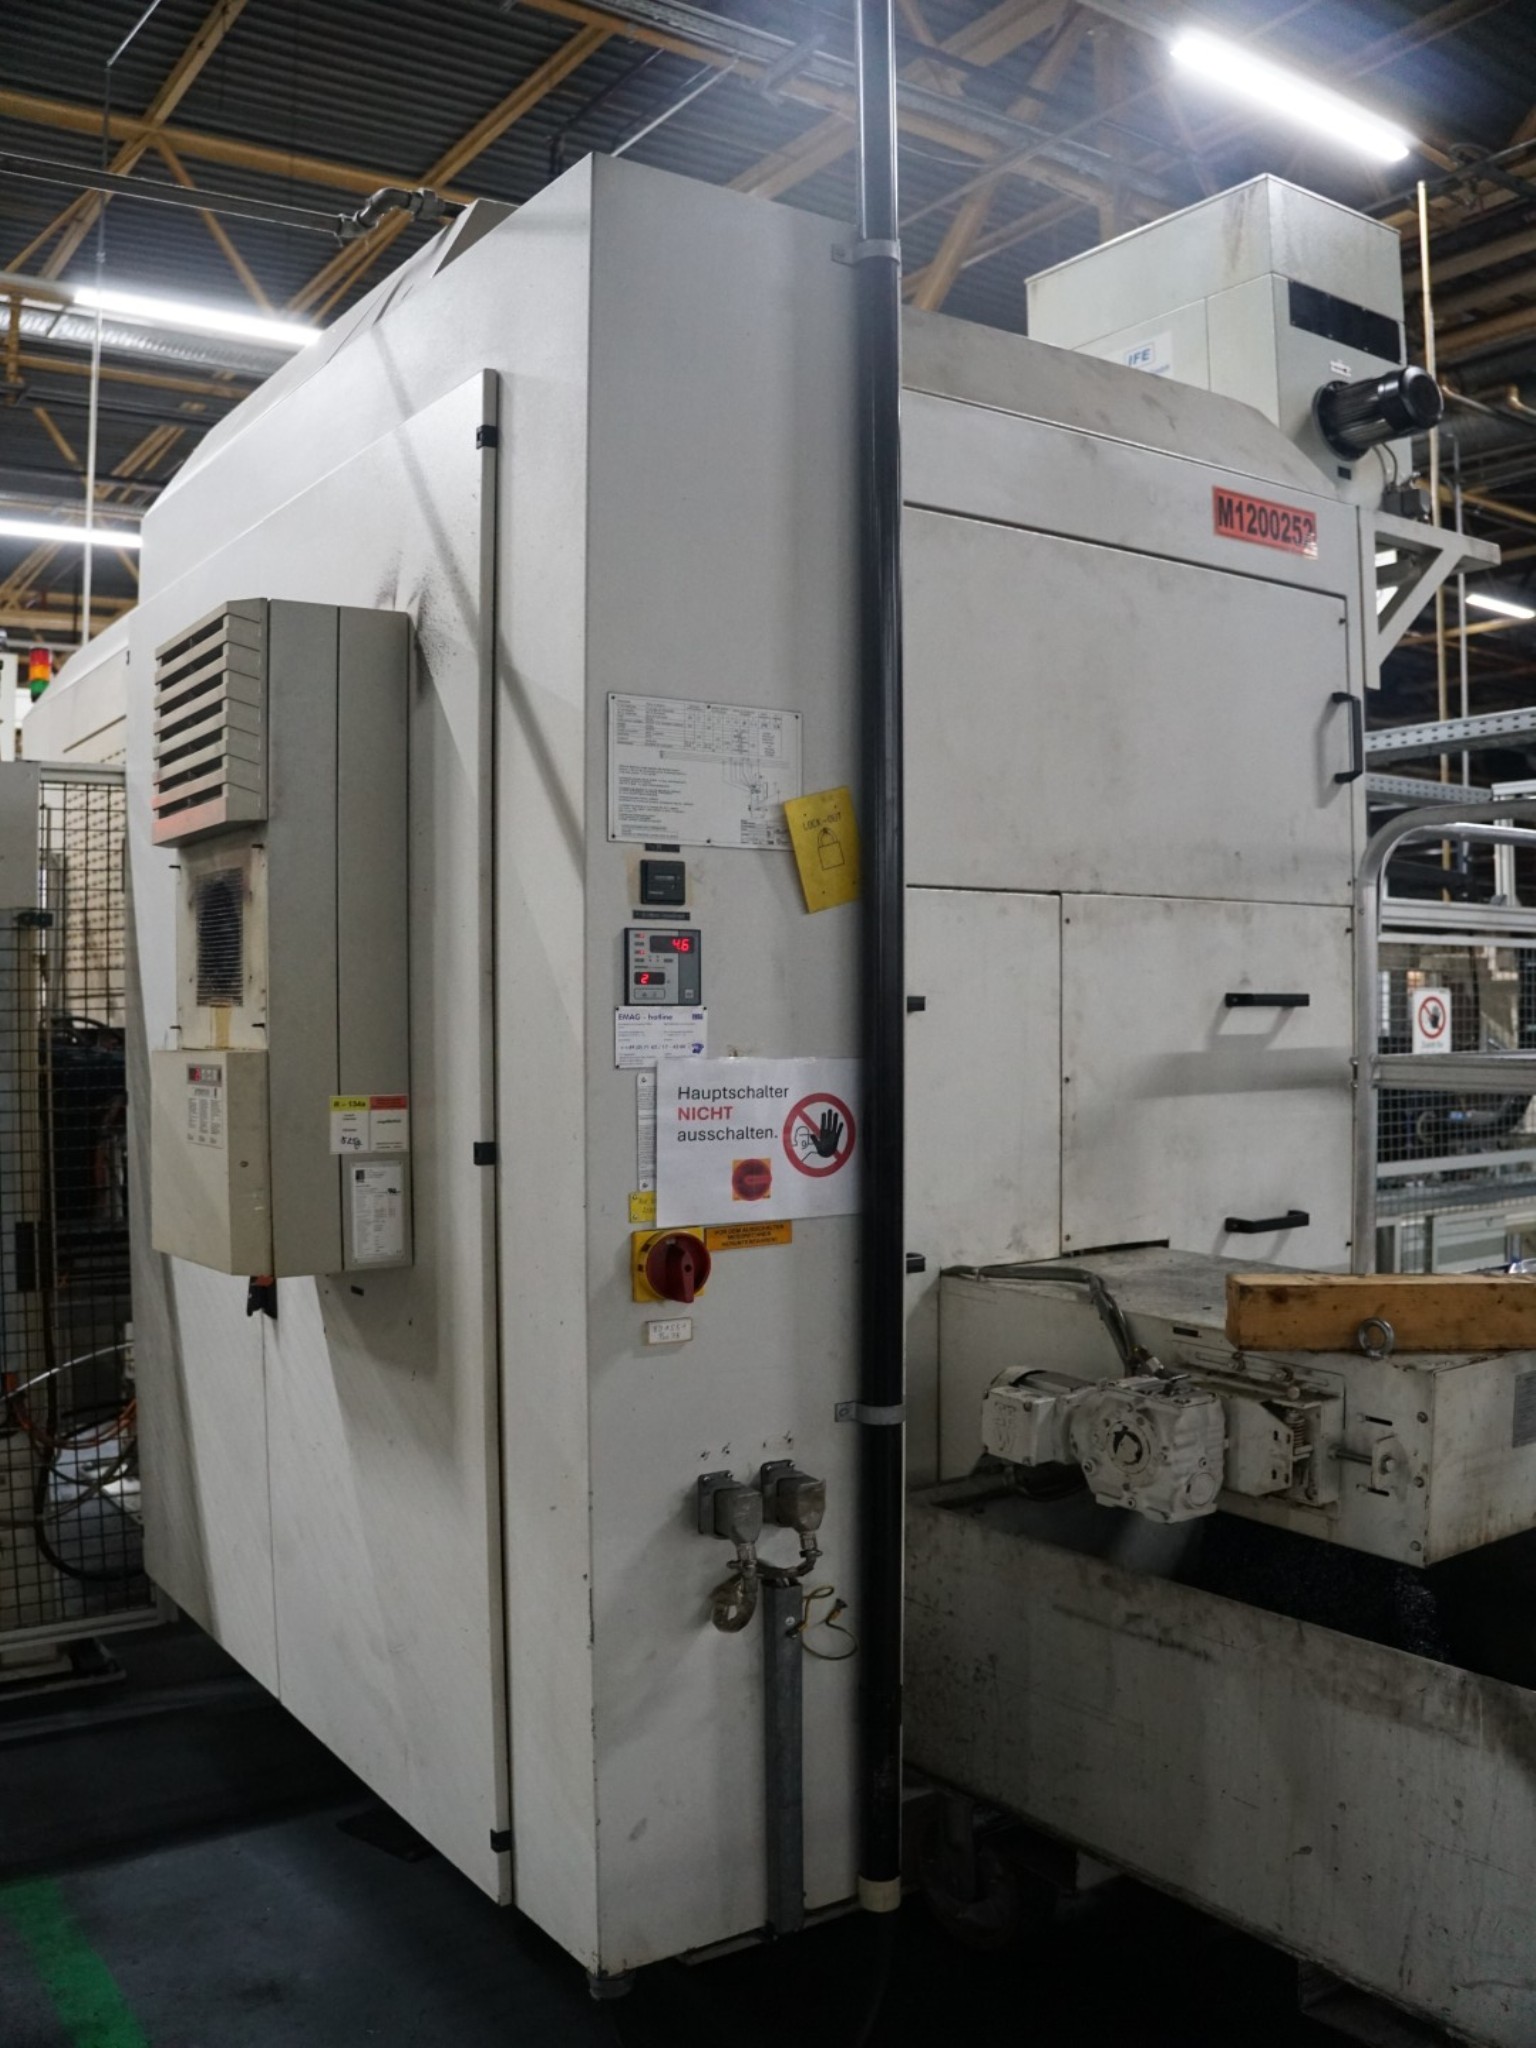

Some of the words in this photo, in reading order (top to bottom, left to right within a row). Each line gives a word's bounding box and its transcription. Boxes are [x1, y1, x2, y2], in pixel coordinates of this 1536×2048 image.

[640, 972, 650, 985] 2
[617, 1013, 641, 1021] EMAG
[647, 1012, 673, 1021] hotline
[677, 1085, 790, 1102] Hauptschalter
[677, 1106, 733, 1121] NICHT
[677, 1126, 779, 1142] ausschalten.
